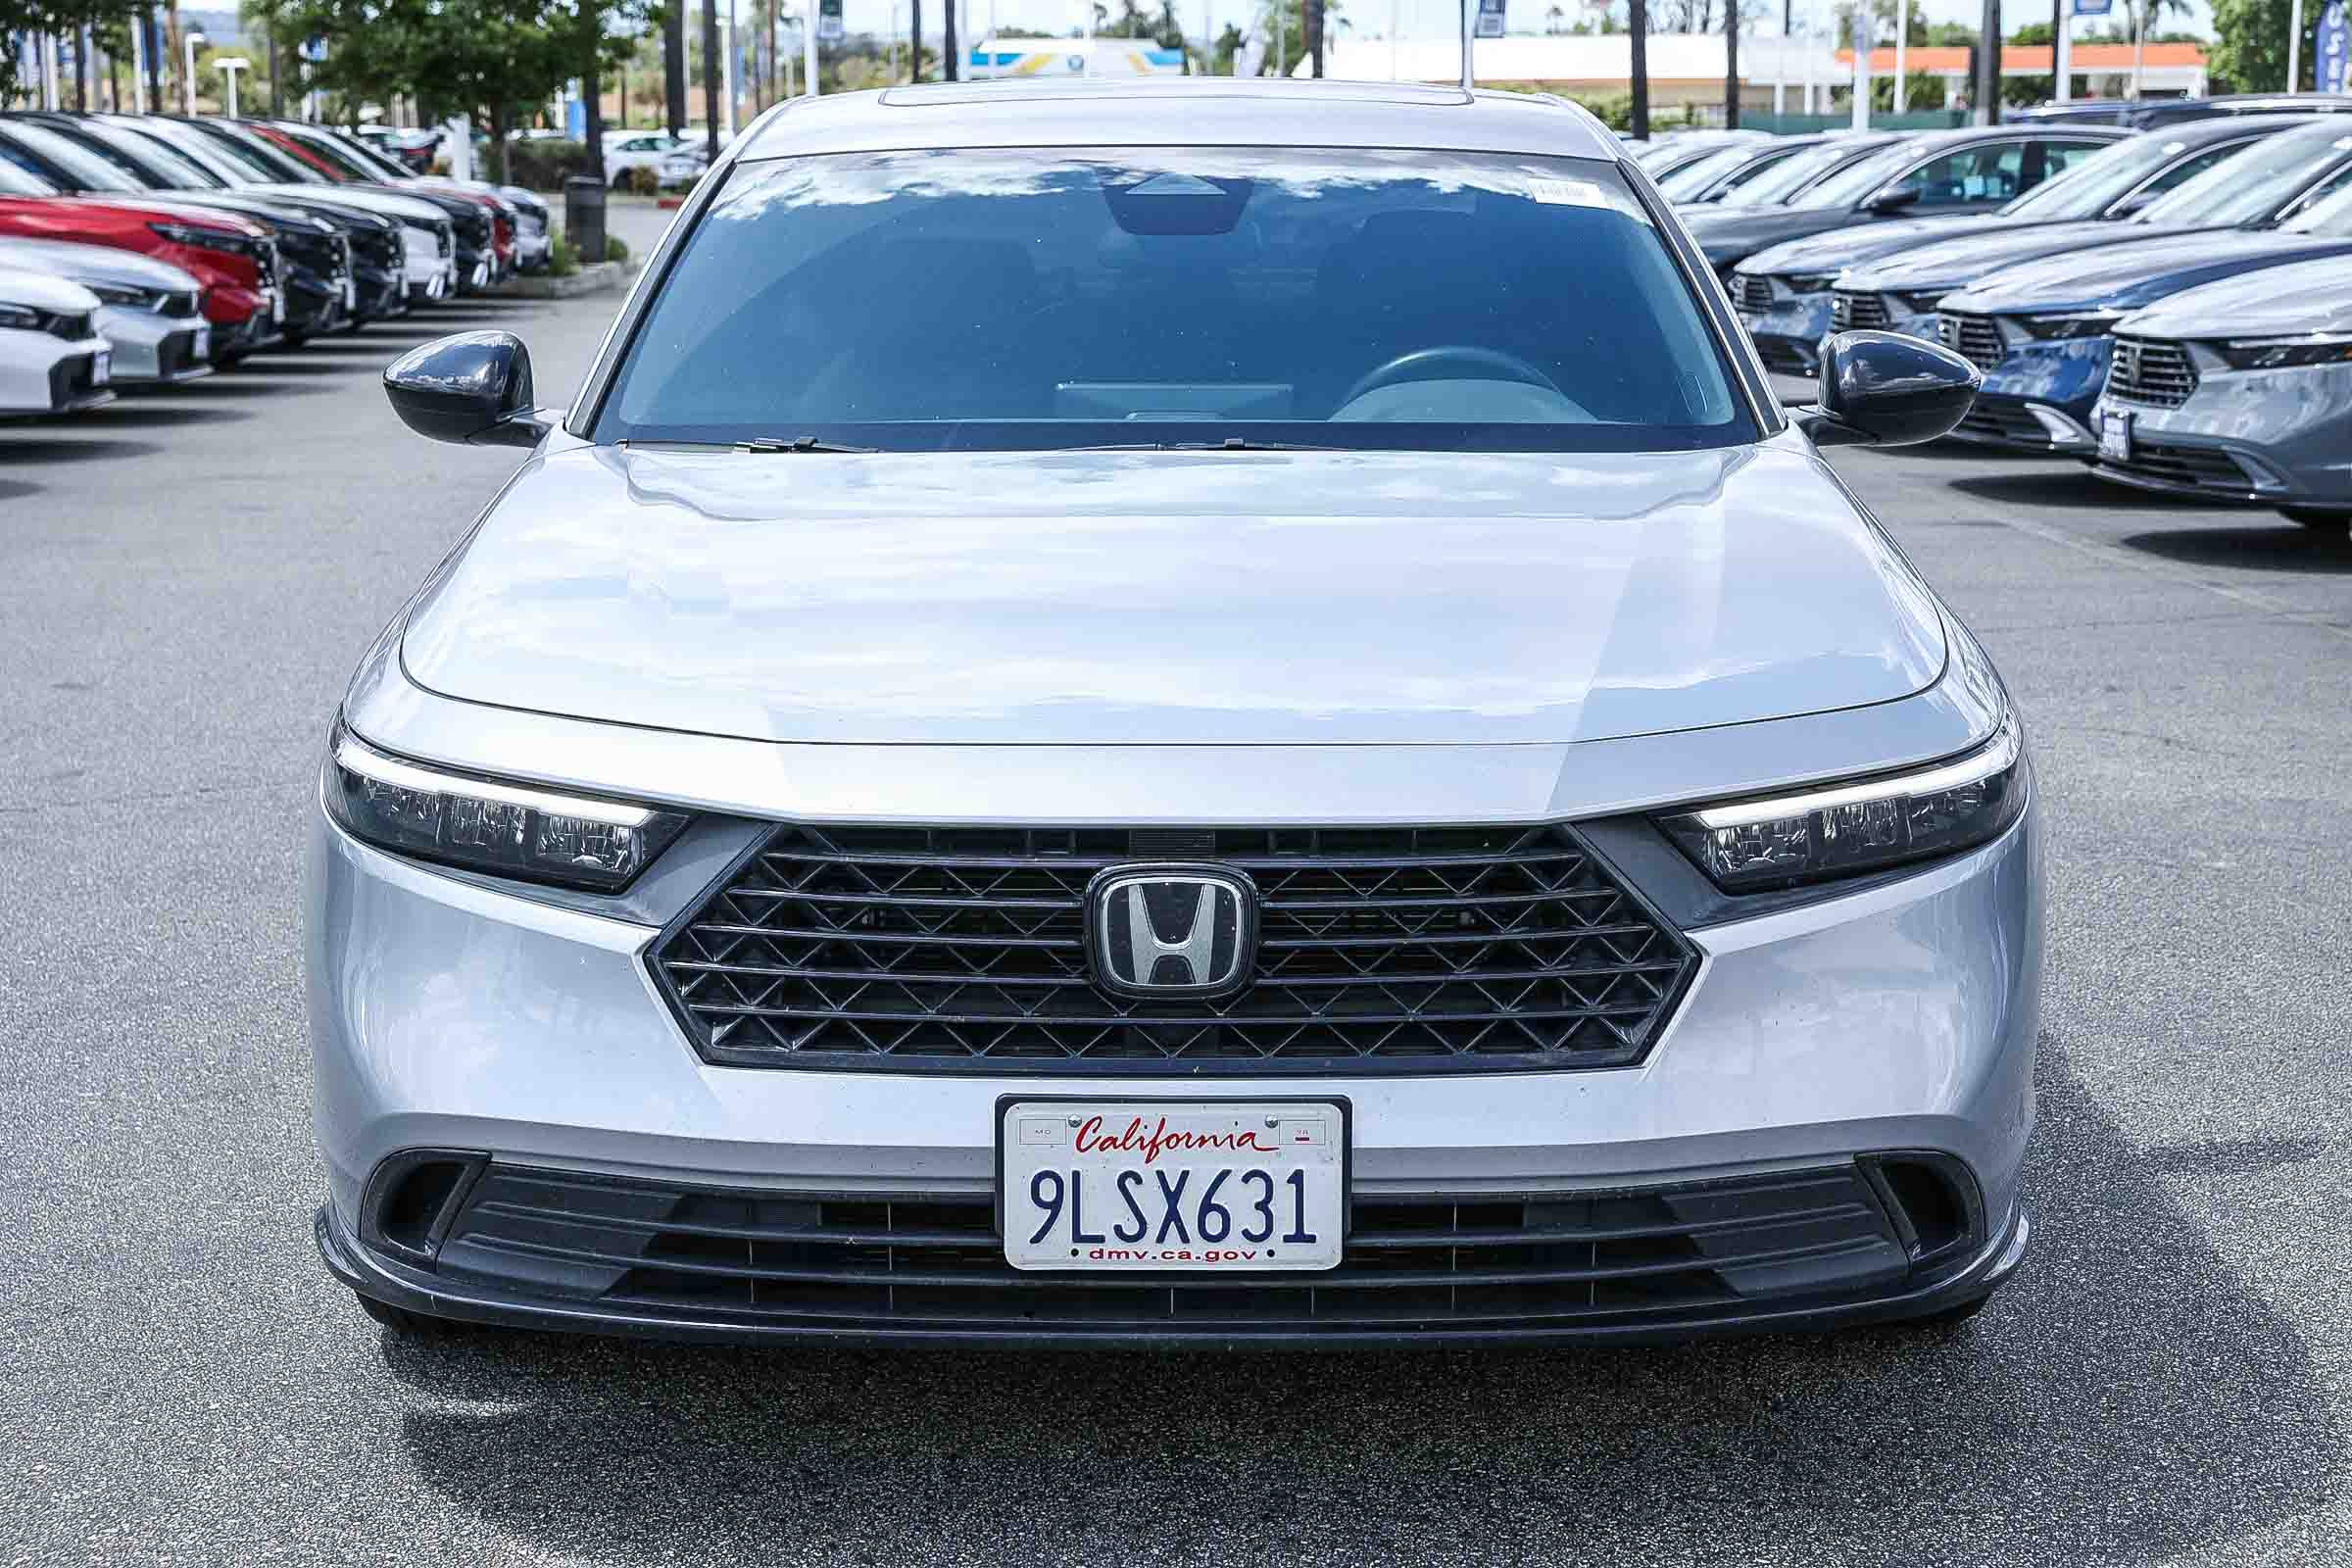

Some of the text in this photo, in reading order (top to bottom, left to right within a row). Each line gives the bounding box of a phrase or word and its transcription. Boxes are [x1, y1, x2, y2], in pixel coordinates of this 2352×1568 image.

[1075, 1116, 1279, 1163] California
[1029, 1168, 1317, 1244] 9LSX631
[1089, 1248, 1257, 1262] dmv.ca.gov
